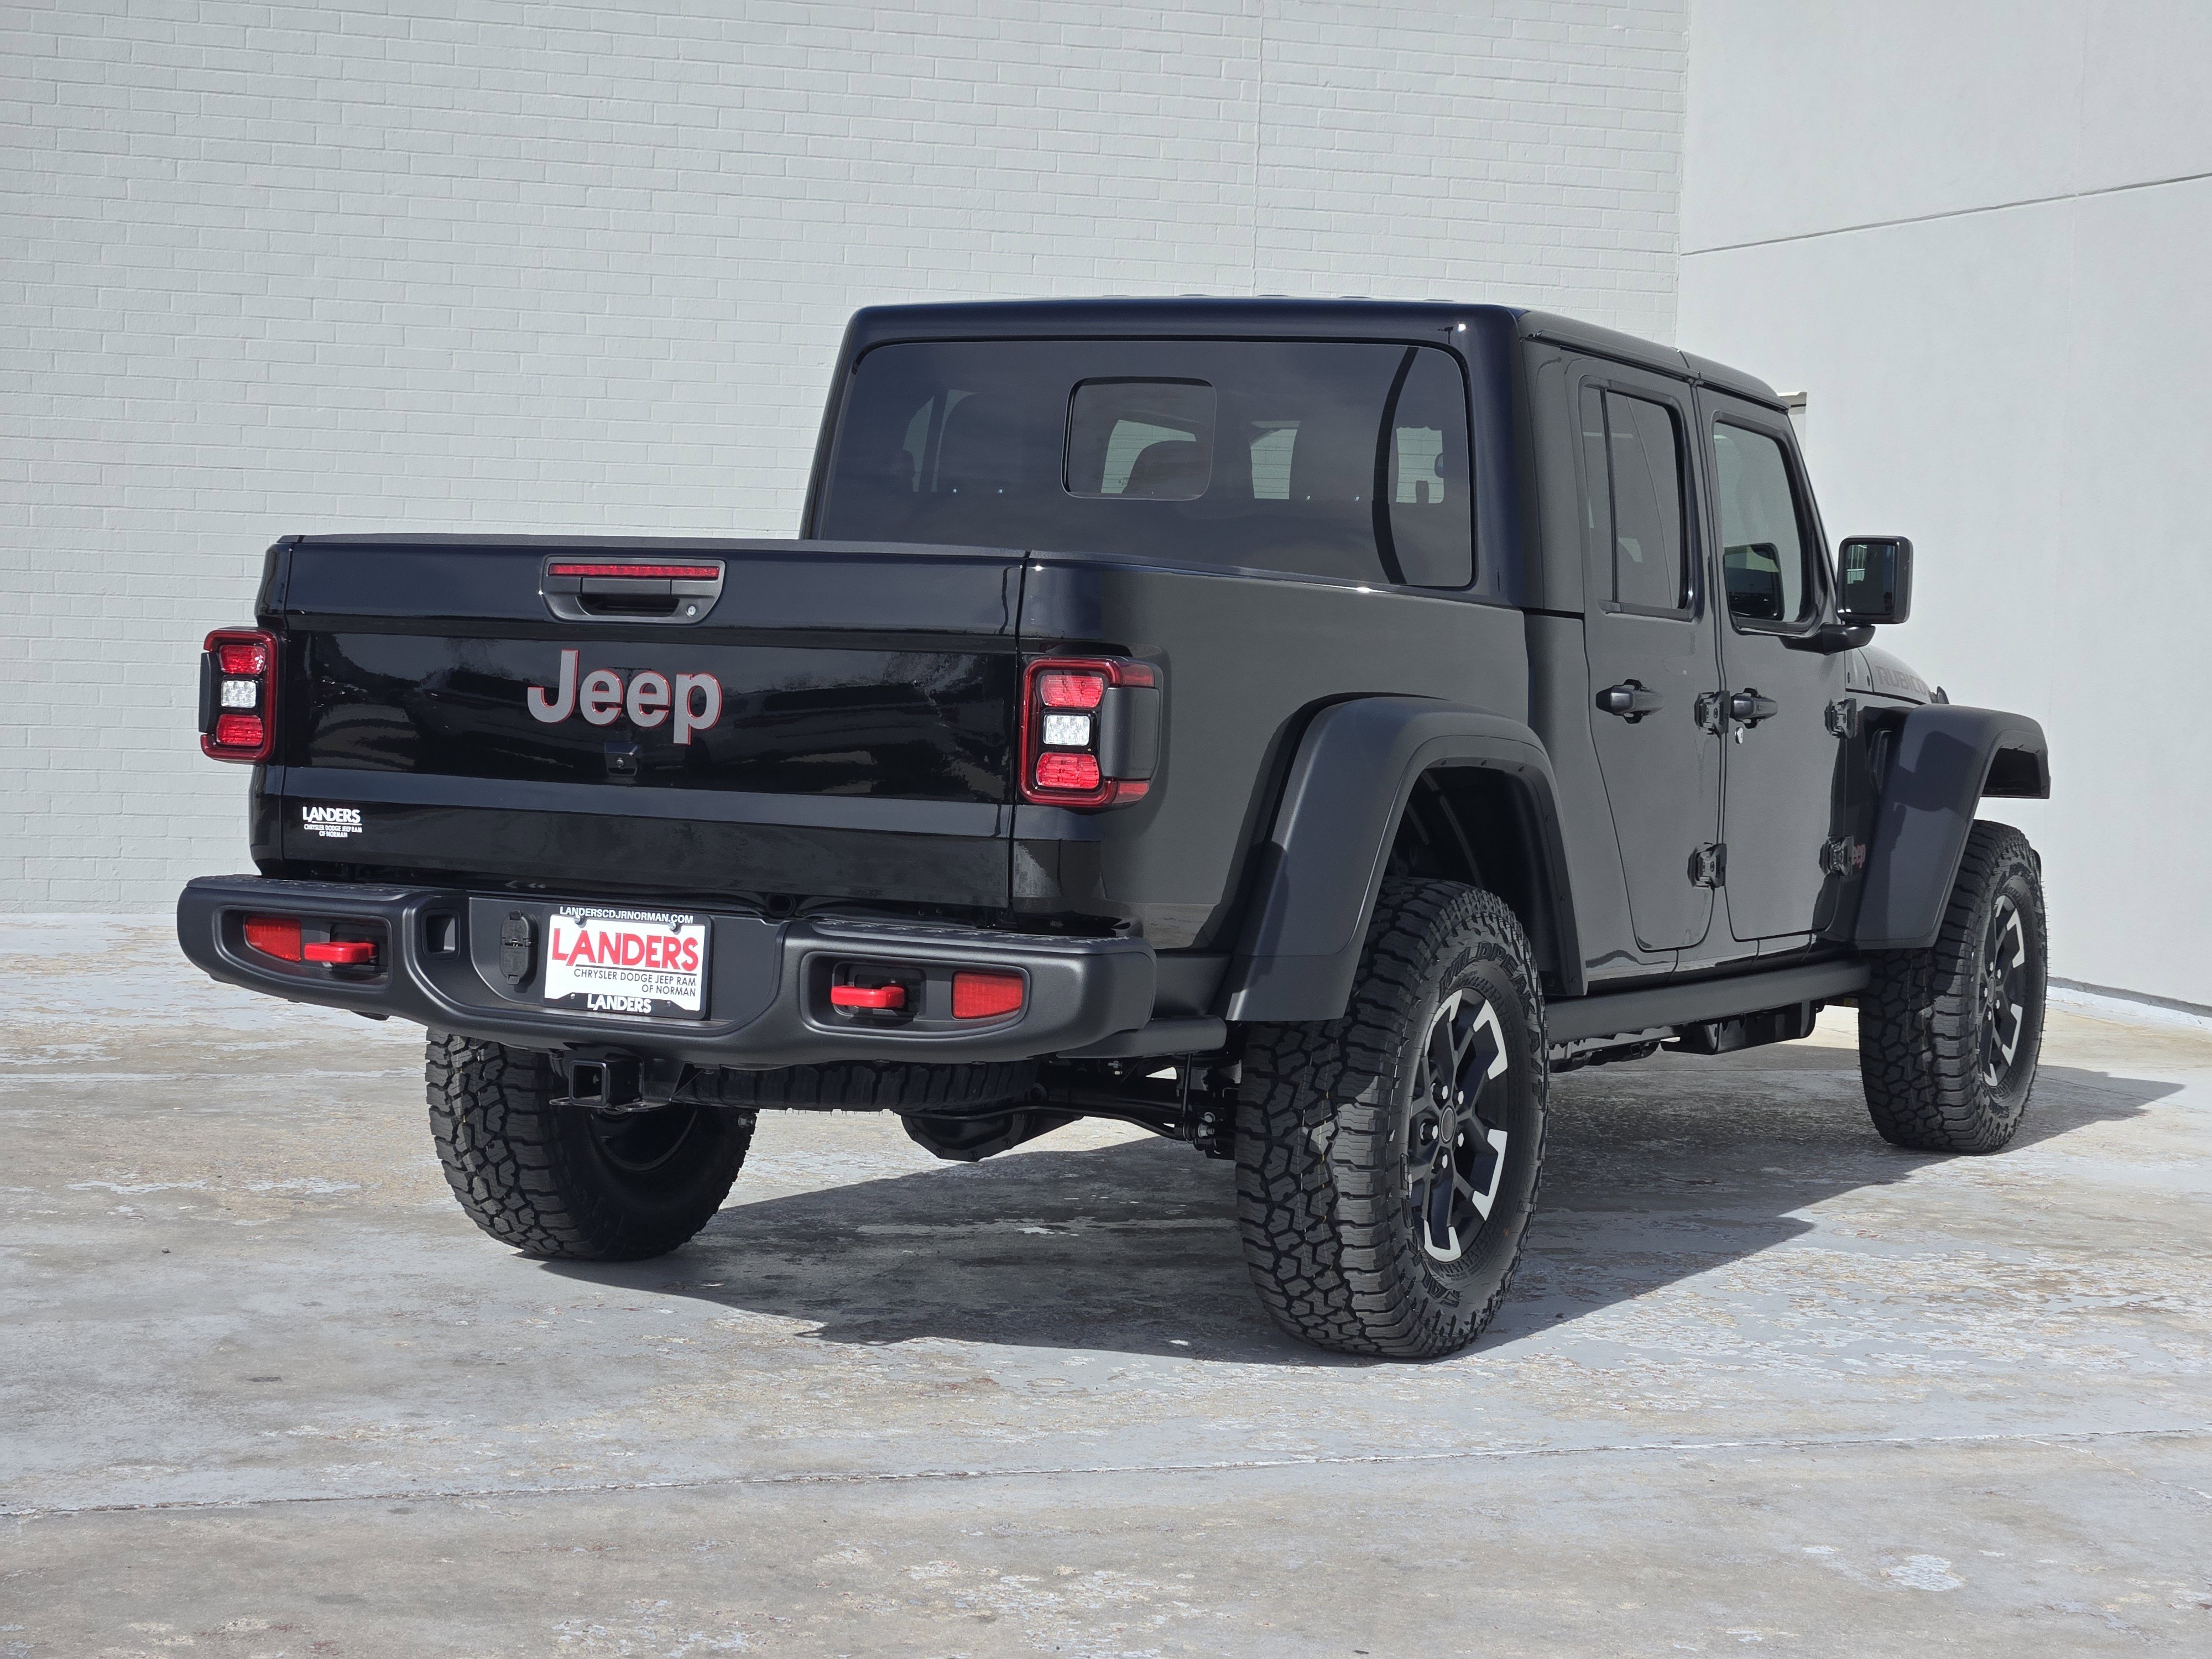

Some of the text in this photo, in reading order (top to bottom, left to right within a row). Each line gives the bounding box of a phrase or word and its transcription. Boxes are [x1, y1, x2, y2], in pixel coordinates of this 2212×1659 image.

[1875, 665, 1928, 696] RUBICO
[528, 649, 723, 745] Jeep
[302, 806, 361, 823] LANDERS
[560, 906, 693, 924] LANDERSCDJRNORMAN.COM
[552, 928, 698, 972] LANDERS
[574, 969, 696, 987] CHRYSLER DODGE JEEP RAM
[1439, 942, 1536, 1021] WILDPEAK
[642, 984, 696, 997] OF NORMAN
[587, 994, 651, 1014] LANDERS
